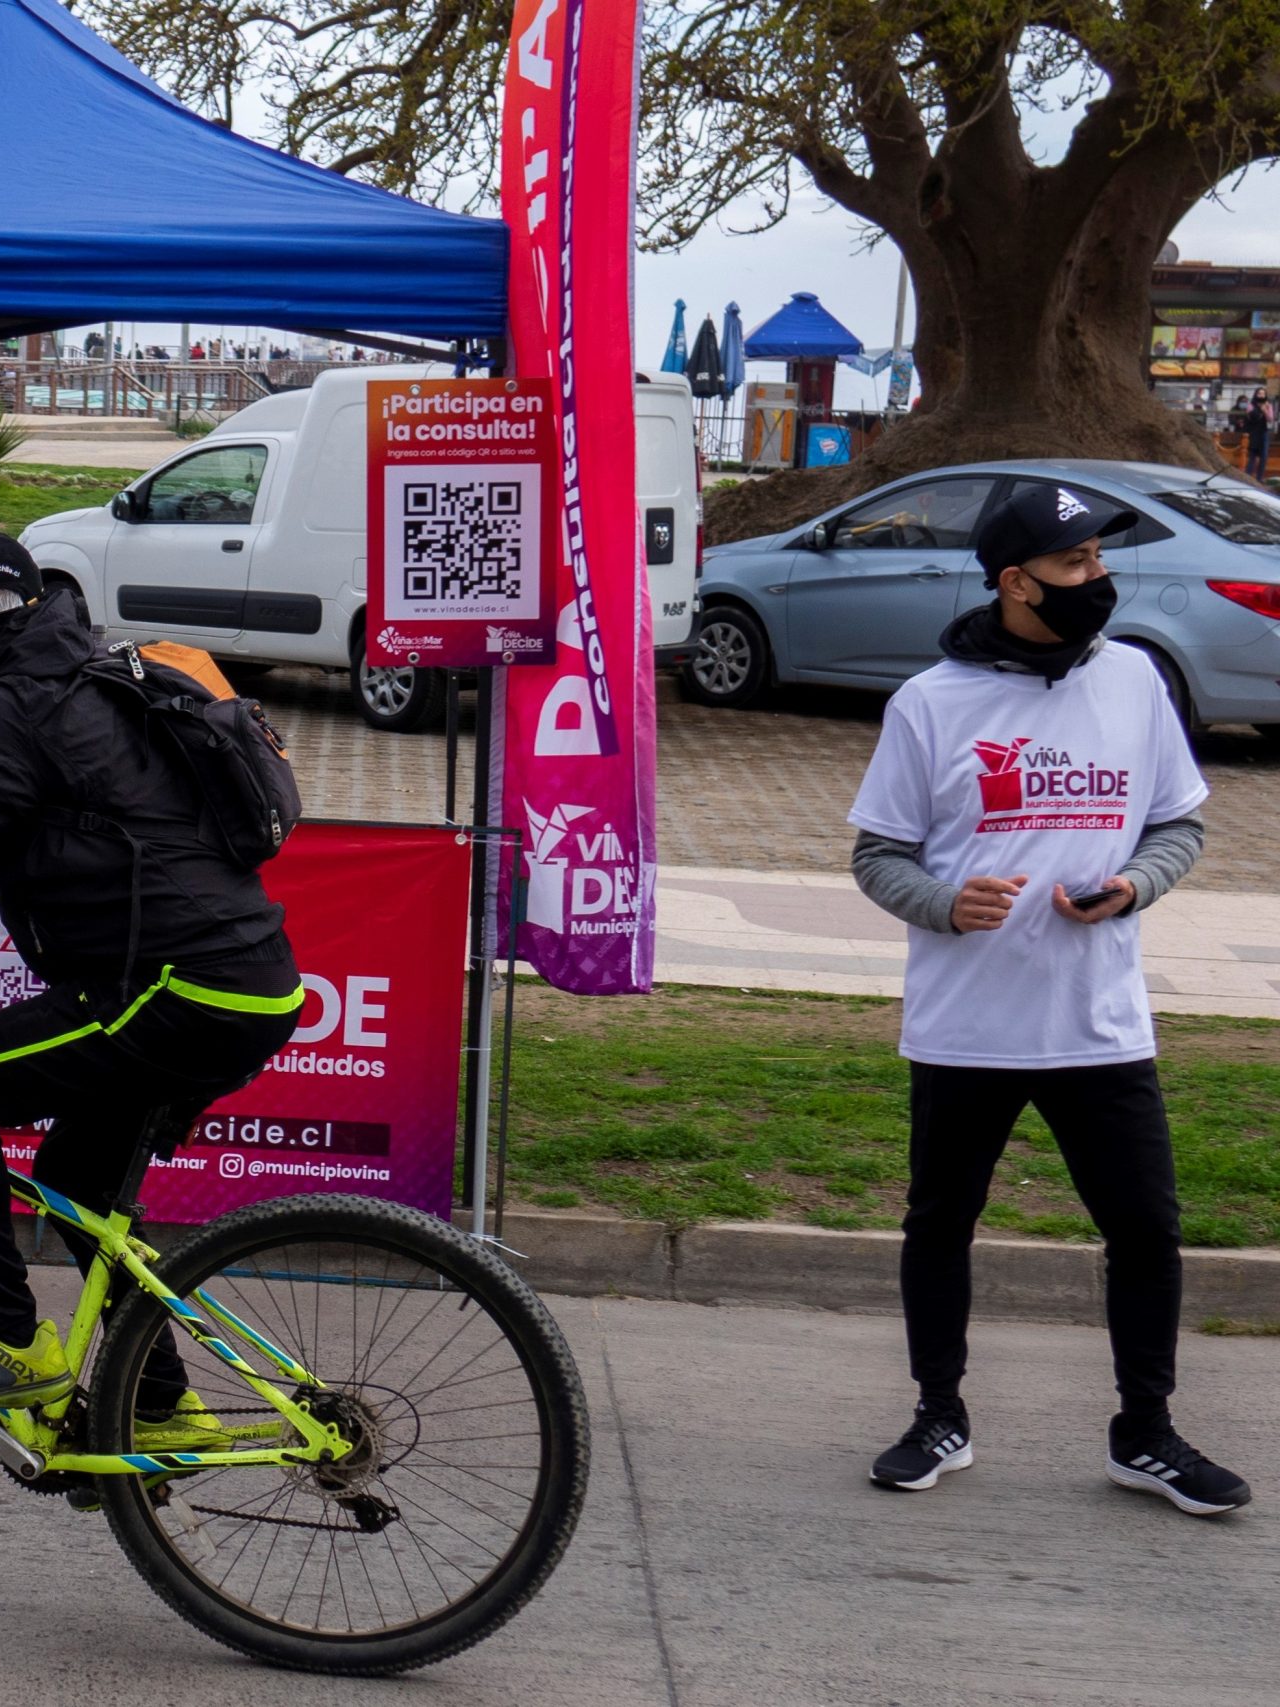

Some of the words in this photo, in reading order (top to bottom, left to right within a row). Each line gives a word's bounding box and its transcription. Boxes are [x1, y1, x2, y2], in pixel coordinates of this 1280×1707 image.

[383, 391, 506, 420] ¡Participa
[511, 396, 543, 412] en
[387, 420, 411, 441] la
[415, 419, 536, 441] consulta!
[420, 449, 436, 457] con
[438, 448, 445, 457] el
[478, 448, 490, 456] QR
[499, 448, 516, 456] sitio
[517, 448, 536, 456] web
[1025, 799, 1072, 810] Municipio
[1074, 799, 1086, 808] de
[984, 815, 1118, 831] www.vinadecide.cl
[288, 973, 390, 1048] DE
[263, 1049, 386, 1078] uidados
[195, 1116, 332, 1148] cide.cl
[248, 1160, 391, 1182] @municipiovina
